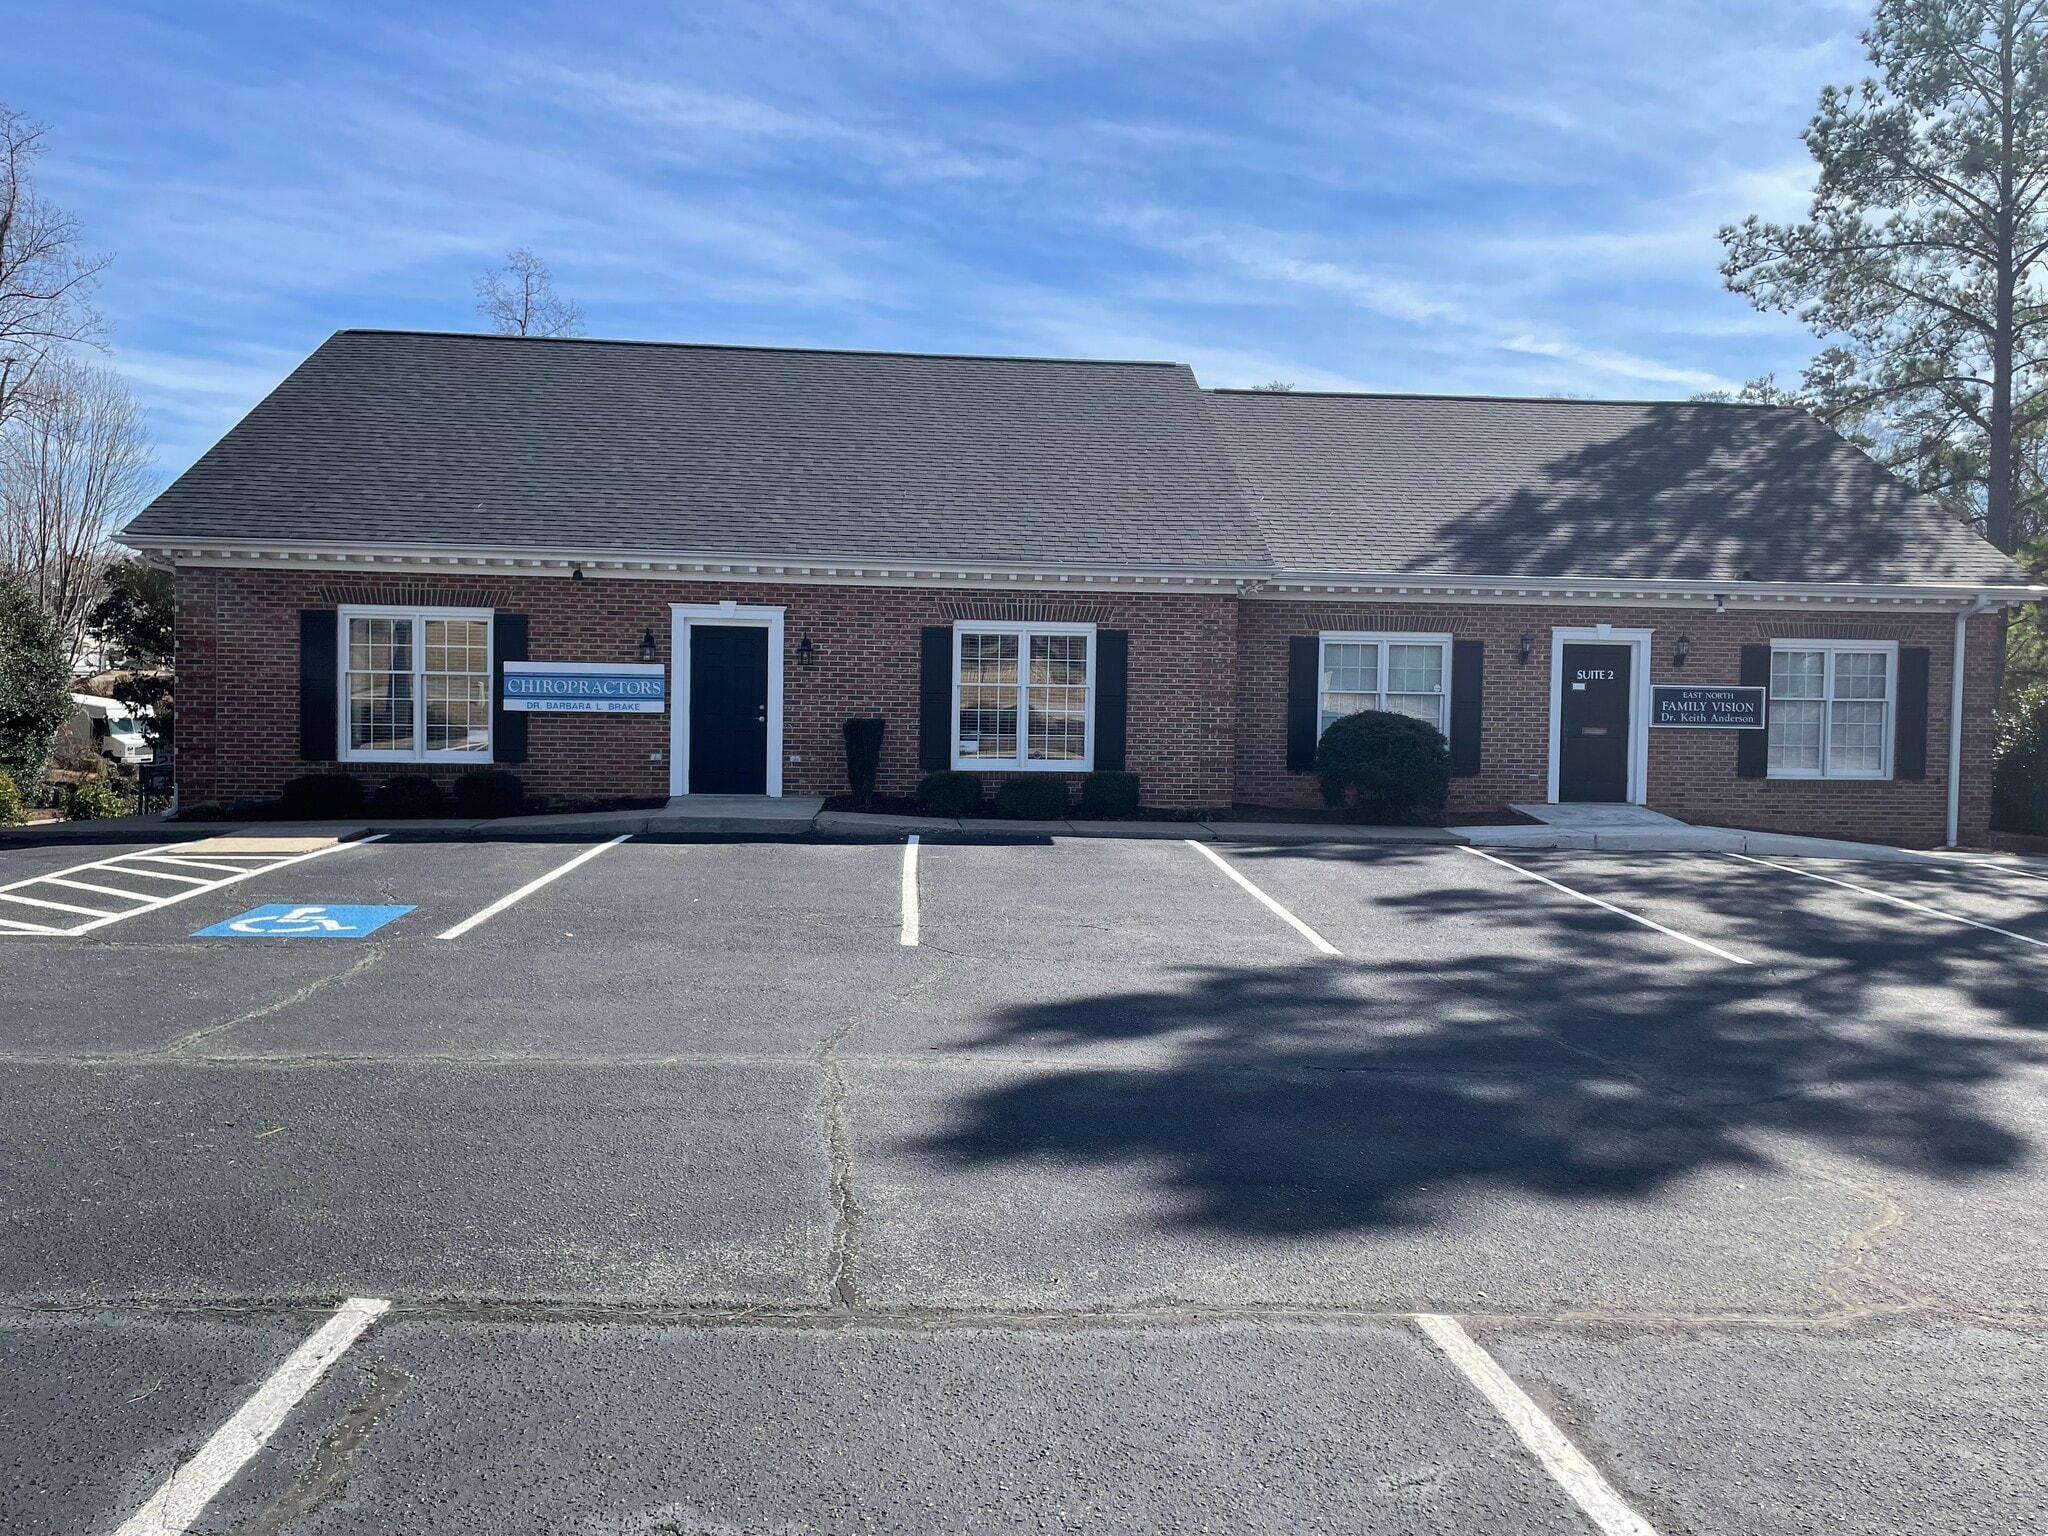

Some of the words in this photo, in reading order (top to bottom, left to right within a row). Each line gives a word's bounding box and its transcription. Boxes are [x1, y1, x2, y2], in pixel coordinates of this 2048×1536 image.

[1576, 669, 1606, 680] SUITE
[1607, 670, 1614, 680] 2
[507, 678, 662, 696] CHIROPRACTORS
[1682, 691, 1702, 699] EAST
[1705, 692, 1734, 700] NORTH
[526, 701, 542, 710] DR.
[546, 702, 592, 711] BARBARA
[596, 703, 605, 711] L.
[608, 702, 641, 711] BRAKE
[1662, 701, 1708, 712] FAMILY
[1711, 701, 1755, 712] VISION
[1661, 712, 1677, 722] Dr.
[1680, 713, 1707, 722] Keith
[1710, 713, 1754, 723] Anderson
